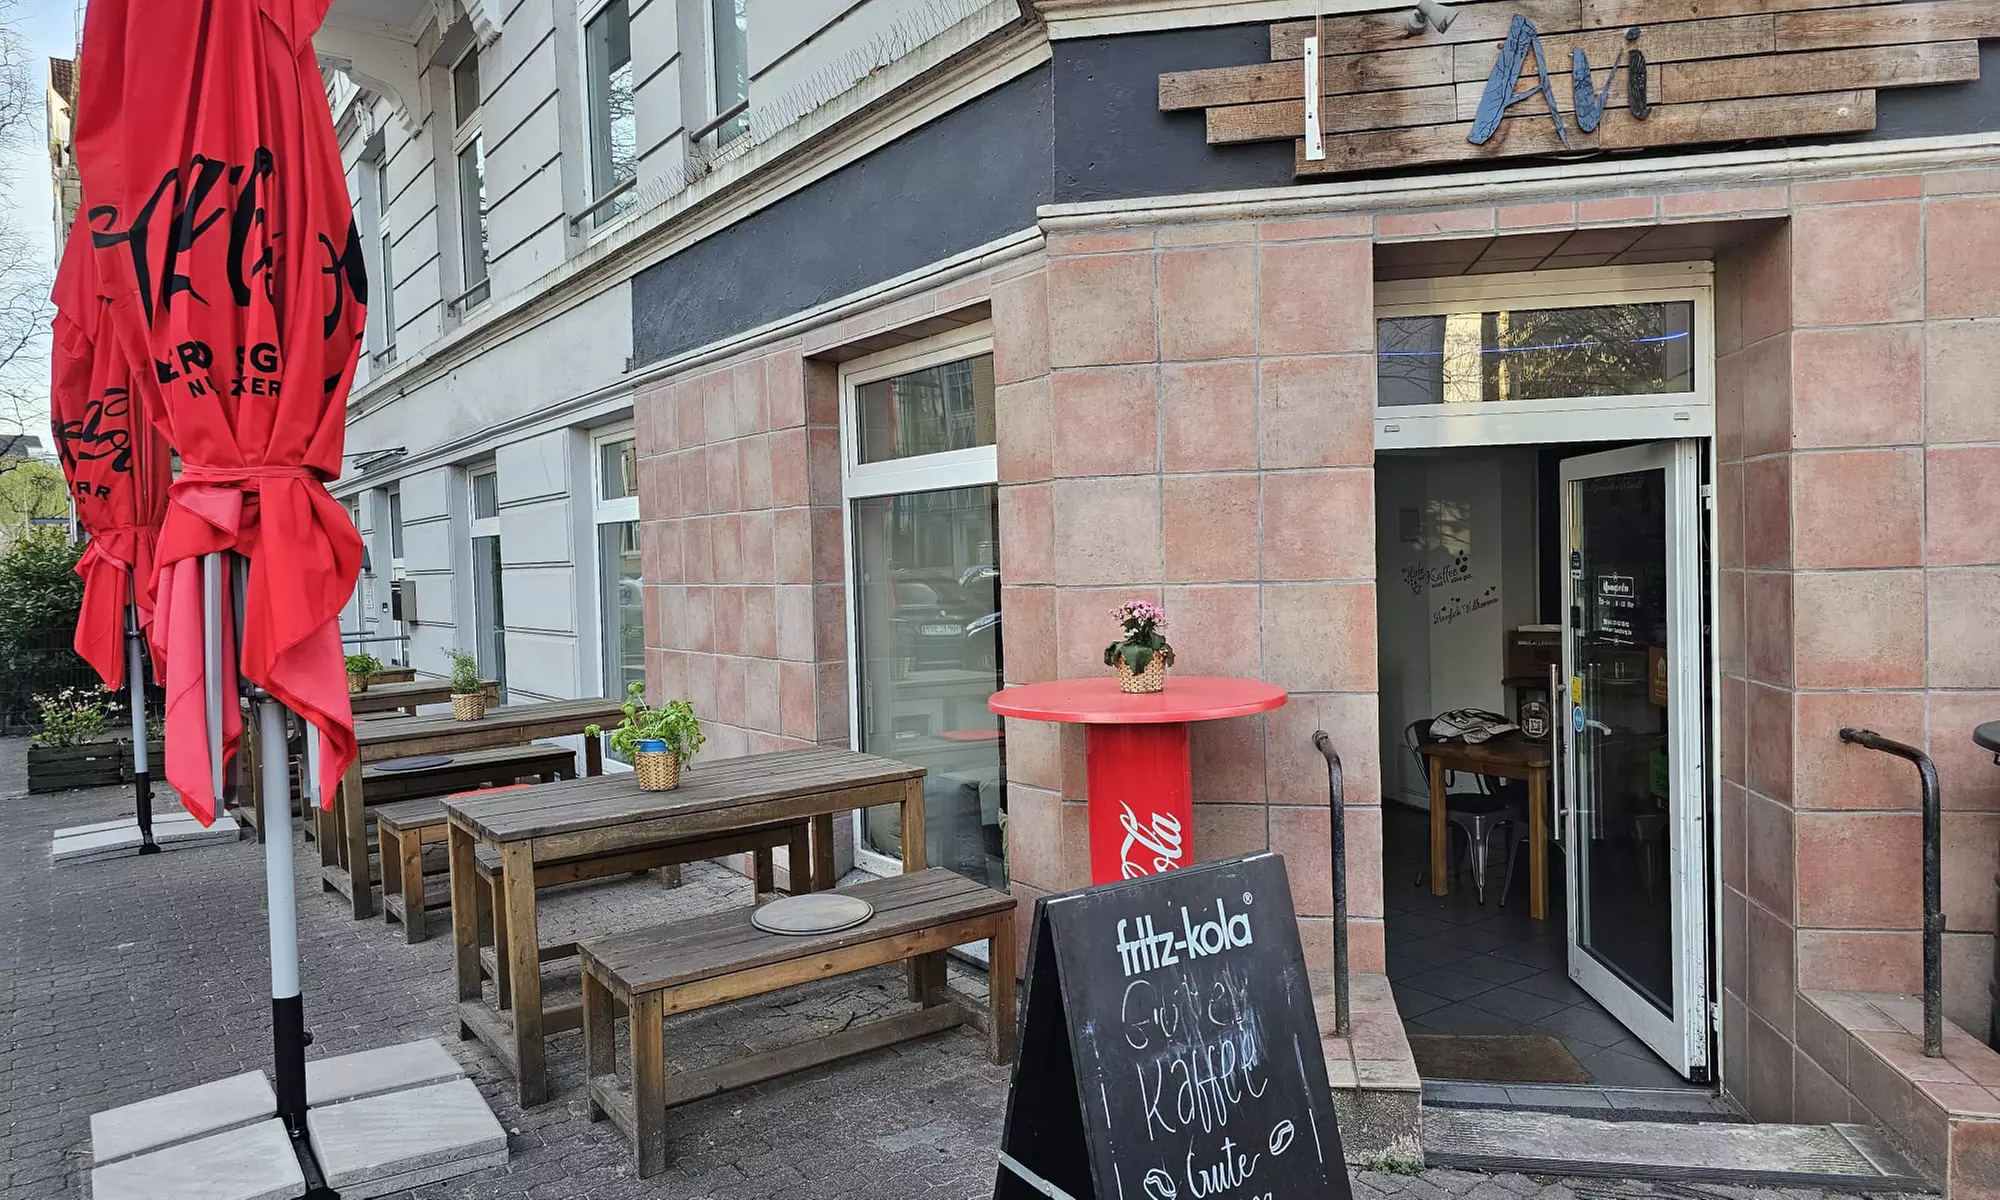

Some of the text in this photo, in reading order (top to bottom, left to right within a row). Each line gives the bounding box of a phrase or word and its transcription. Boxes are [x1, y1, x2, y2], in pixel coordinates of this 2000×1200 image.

[1467, 14, 1652, 150] Avi
[1425, 564, 1458, 584] Kaffee
[1136, 1035, 1269, 1141] Kaffee
[1186, 1137, 1261, 1199] Gute
